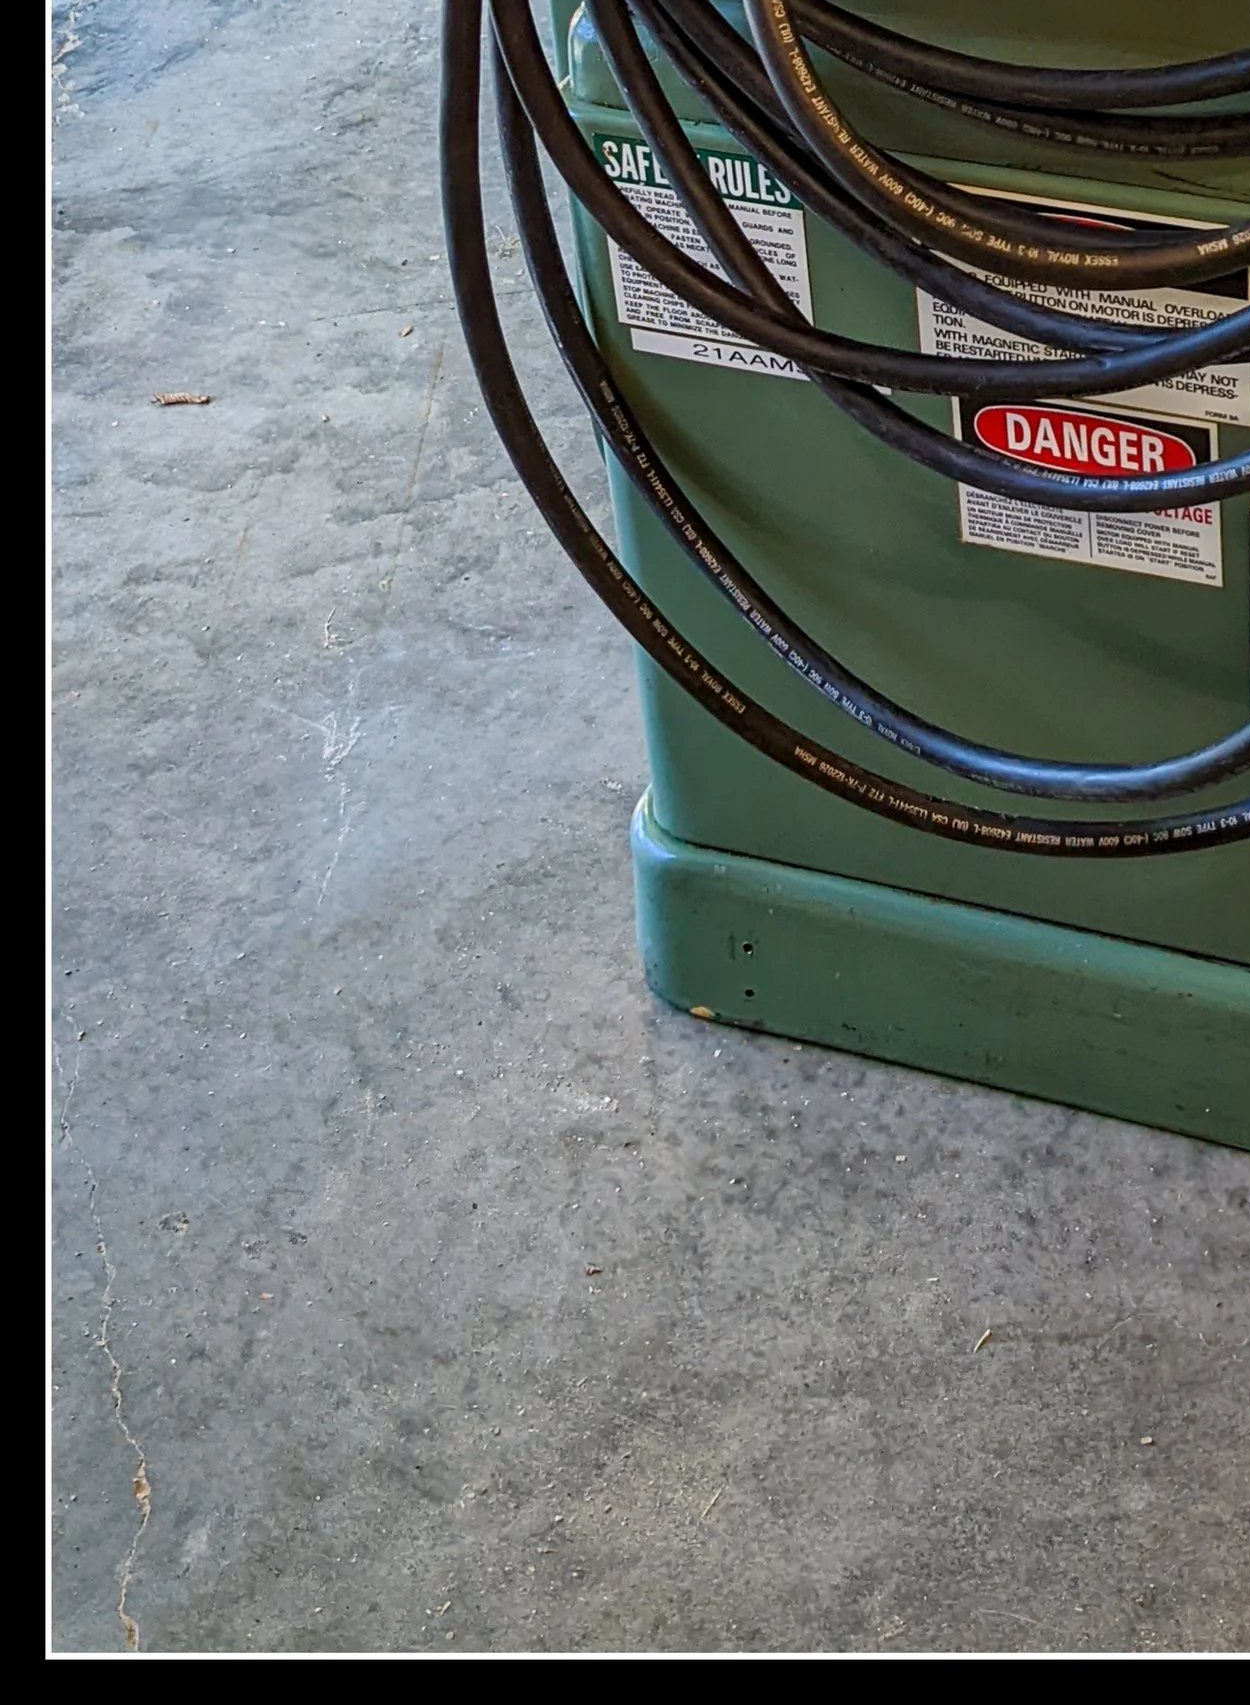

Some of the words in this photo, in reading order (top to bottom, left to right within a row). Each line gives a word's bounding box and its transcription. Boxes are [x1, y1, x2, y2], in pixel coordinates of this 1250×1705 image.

[790, 47, 818, 93] E42608-L
[811, 95, 852, 145] RESISTANT
[849, 143, 880, 175] WATER
[602, 140, 670, 184] SAF
[707, 155, 792, 204] RULES
[878, 172, 904, 195] 600V
[630, 196, 653, 204] ATING
[655, 198, 682, 208] MACHI
[653, 191, 675, 200] READ
[646, 206, 681, 217] OPERATE
[729, 204, 761, 215] MANUAL
[762, 209, 792, 219] BEFORE
[904, 191, 934, 217] (-40C)
[654, 214, 692, 226] POSITION.
[935, 212, 956, 229] 90C
[654, 224, 680, 233] ACHINE
[742, 222, 774, 232] GUARDS
[778, 227, 794, 236] AND
[671, 234, 701, 244] FASTEN
[750, 239, 793, 250] GROUNDED.
[986, 234, 1012, 253] TYPE
[1197, 237, 1228, 256] MSHA
[777, 259, 797, 267] LONG
[1047, 250, 1079, 265] ROYAL
[1084, 255, 1119, 267] ESSEX
[620, 263, 634, 271] USE
[621, 269, 631, 277] TO
[779, 274, 799, 283] WAT-
[623, 284, 642, 293] STOP
[643, 289, 676, 299] MACHINE
[984, 274, 1048, 292] EQUIPPED
[1056, 286, 1090, 302] WITH
[1099, 293, 1157, 312] MANUAL
[1164, 303, 1232, 321] OVERLOA
[624, 292, 660, 303] CLEANING
[662, 298, 685, 308] CHIPS
[625, 300, 643, 308] KEEP
[646, 303, 660, 311] THE
[662, 306, 688, 316] FLOOR
[626, 307, 641, 315] AND
[646, 310, 664, 319] FREE
[669, 315, 691, 324] FROM
[1068, 299, 1089, 313] ON
[1091, 304, 1140, 321] MOTOR
[1142, 311, 1155, 323] IS
[1157, 315, 1207, 328] DEPRE
[626, 313, 656, 324] GREASE
[670, 321, 703, 333] MINIMIZE
[705, 327, 719, 336] THE
[932, 314, 966, 328] TION.
[933, 327, 968, 343] WITH
[972, 333, 1039, 355] MAGNETIC
[1043, 347, 1086, 360] STAR
[935, 340, 951, 351] BE
[1210, 375, 1239, 388] NOT
[1175, 380, 1238, 399] DEPRESS-
[1205, 410, 1227, 420] FORM
[1006, 412, 1165, 473] DANGER
[1162, 474, 1206, 490] RESISTANT
[1208, 467, 1238, 484] WATER
[967, 499, 989, 508] AVANT
[991, 501, 1029, 514] D'ENLEVER
[1041, 510, 1082, 524] COUVERCLE
[978, 508, 1003, 517] MOTEUR
[1033, 517, 1072, 529] PROTECTION
[1152, 505, 1213, 525] OLTAGE
[1013, 525, 1041, 535] CONTACT
[1096, 514, 1142, 528] DISCONNECT
[1144, 522, 1170, 532] POWER
[1172, 527, 1200, 538] BEFORE
[1096, 521, 1135, 534] REMOVING
[1136, 527, 1161, 538] COVER
[1006, 537, 1035, 548] POSITION
[1096, 529, 1120, 538] MOTOR
[1121, 533, 1152, 544] EQUIPPED
[1172, 542, 1199, 552] MANUAL
[1097, 535, 1114, 543] OVER
[1115, 539, 1132, 547] LOAD
[1151, 545, 1171, 554] START
[1097, 542, 1122, 551] BUTTON
[719, 574, 751, 611] RESISTANT
[749, 609, 771, 635] WATER
[722, 690, 747, 714] ESSEX
[793, 745, 817, 766] MSHA
[868, 786, 885, 801] FT2
[930, 811, 949, 826] CSA
[951, 816, 969, 831] (UL)
[1220, 815, 1238, 830] 10-3
[1173, 825, 1192, 839] SOW
[1196, 821, 1217, 834] TYPE
[1016, 830, 1060, 848] RESISTANT
[1064, 835, 1095, 848] WATER
[1099, 835, 1119, 847] 600V
